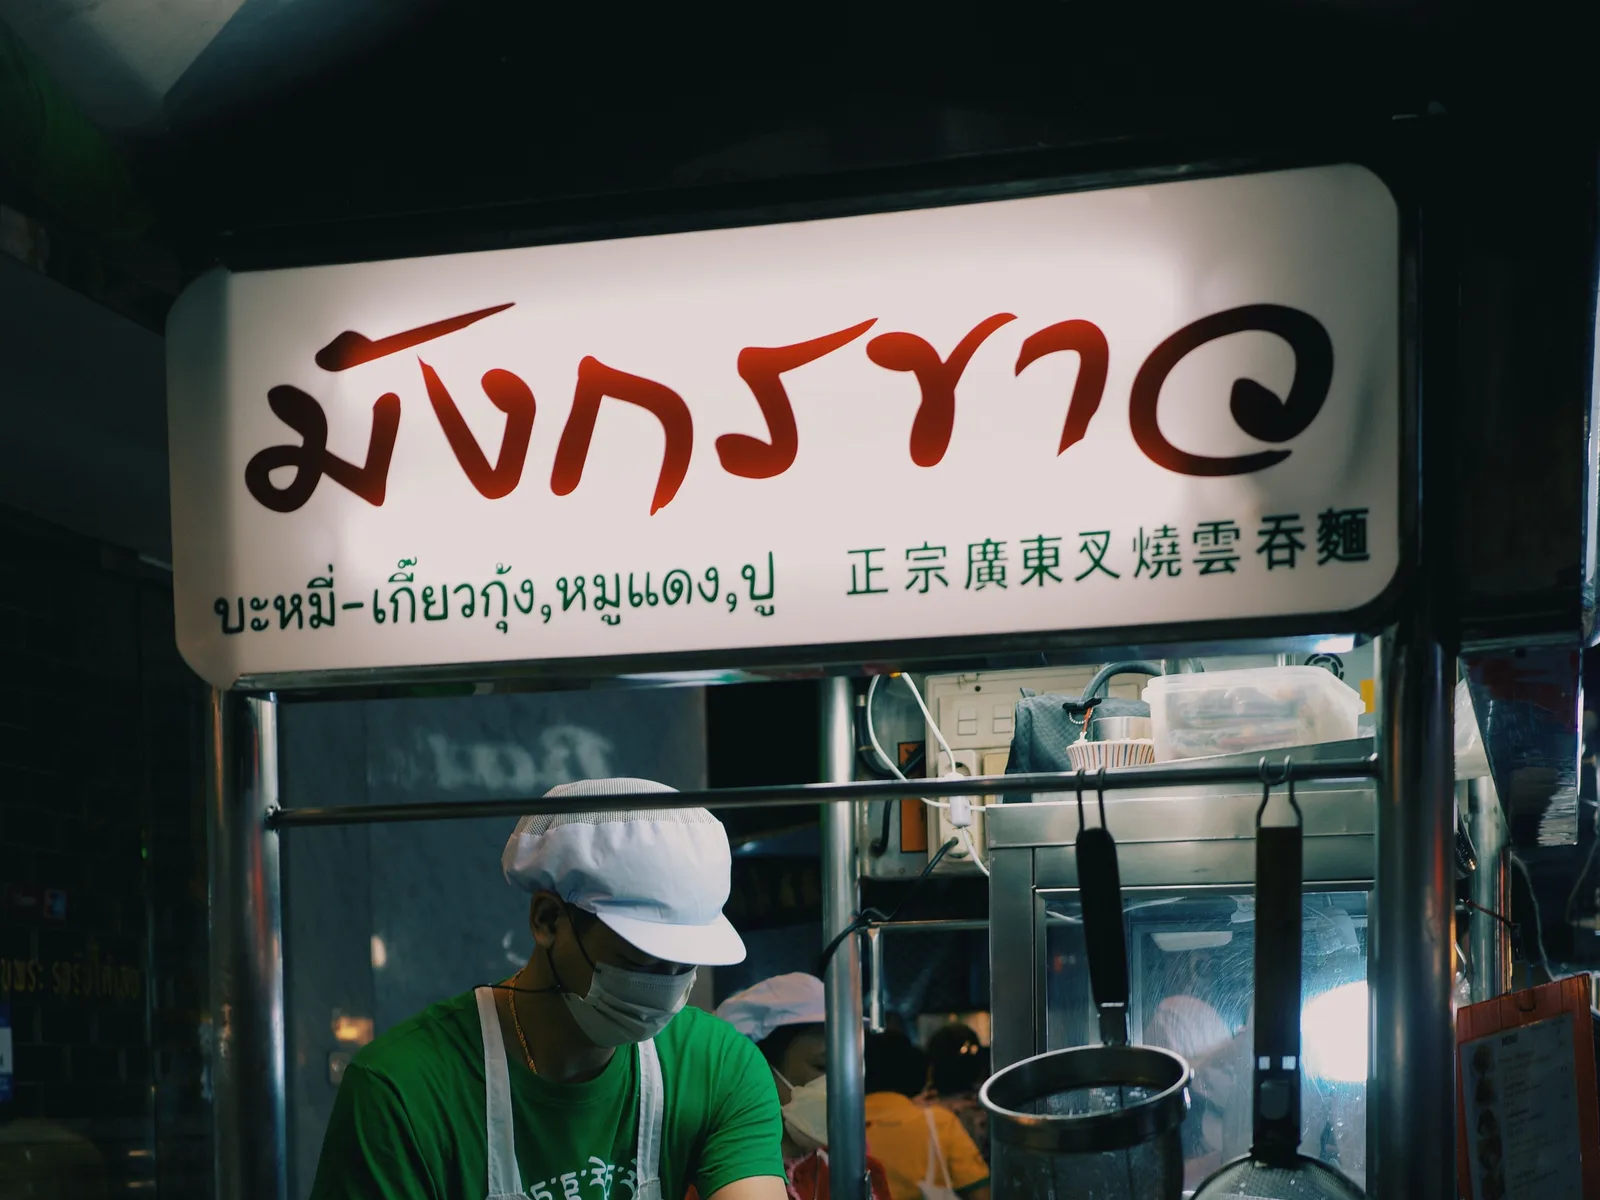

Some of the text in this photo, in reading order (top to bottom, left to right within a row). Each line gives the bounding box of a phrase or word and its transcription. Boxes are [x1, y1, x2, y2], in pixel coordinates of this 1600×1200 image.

[245, 302, 1333, 516] มังกรขาว
[847, 506, 1370, 595] 正宗廣東叉燒雲吞麵
